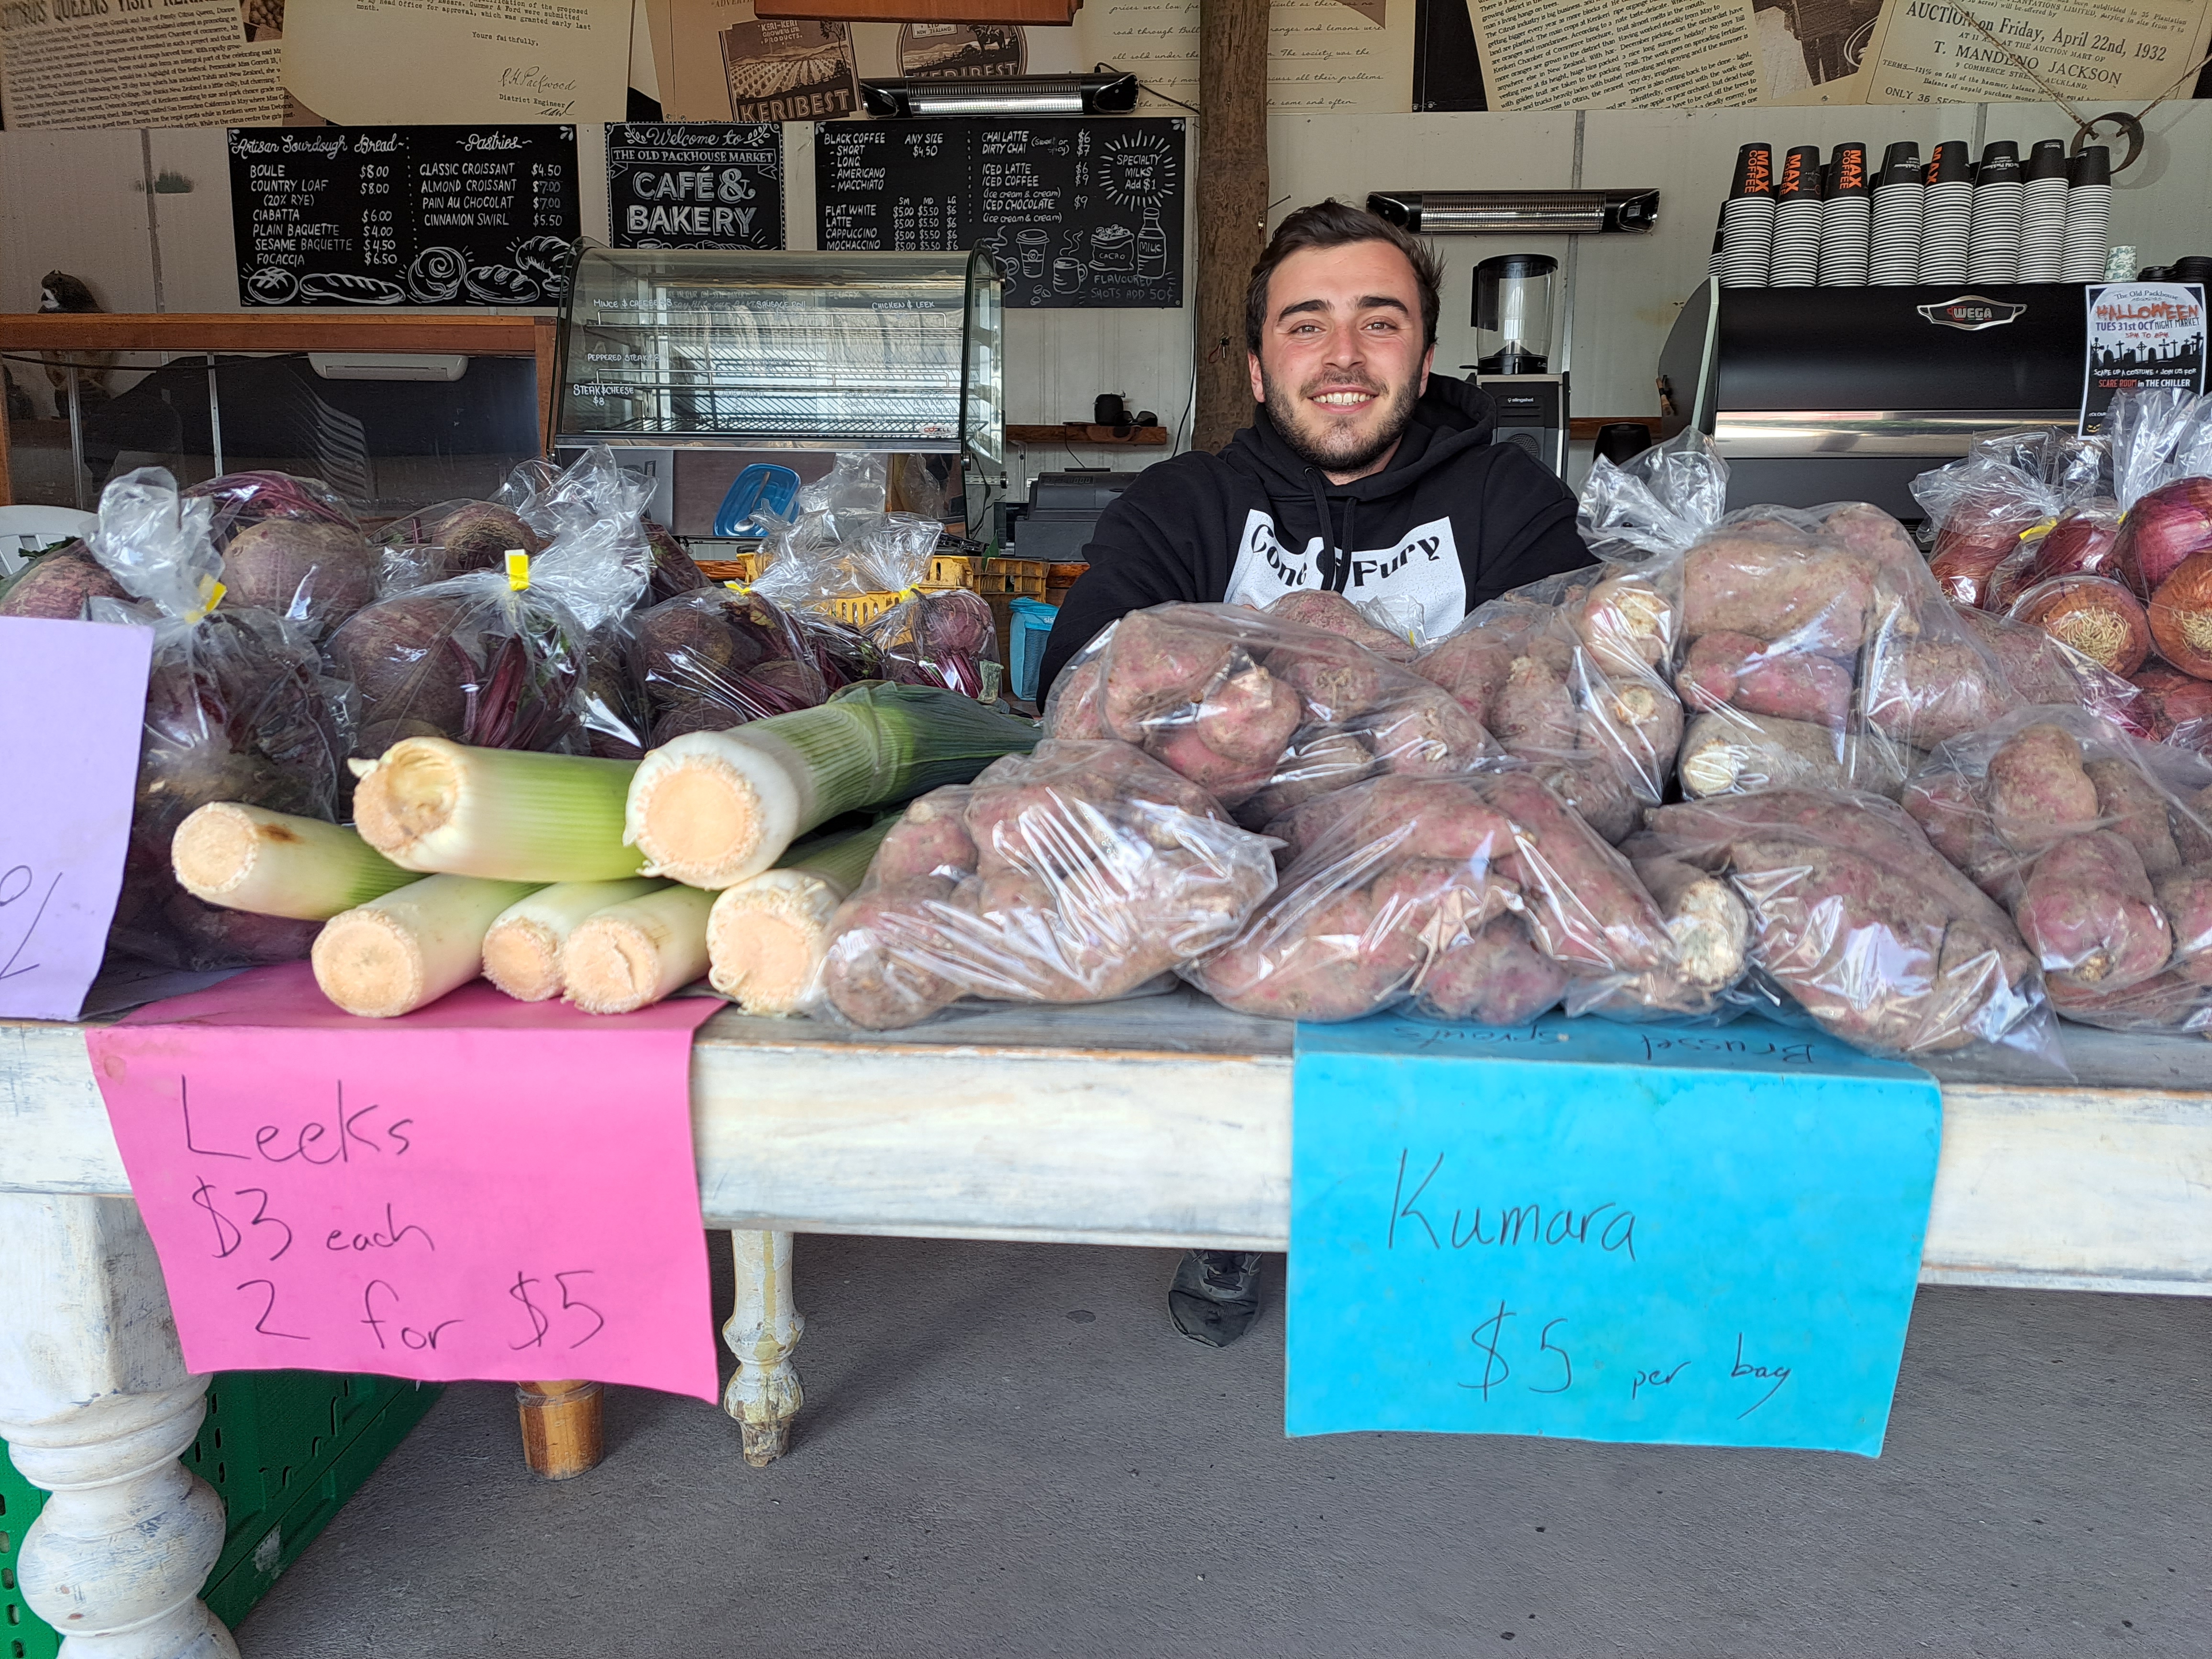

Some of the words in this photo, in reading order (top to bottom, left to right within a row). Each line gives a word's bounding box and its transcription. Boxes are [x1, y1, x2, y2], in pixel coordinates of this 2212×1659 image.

[1698, 12, 1728, 24] orchardist
[760, 20, 798, 32] KERI-KERI
[1906, 1, 1975, 28] AUCTION
[1979, 20, 1993, 31] on
[1999, 17, 2045, 42] Friday,
[2052, 27, 2089, 47] April
[2090, 34, 2126, 57] 22nd,
[2134, 43, 2167, 61] 1932
[472, 31, 493, 40] Yours
[497, 34, 539, 46] faithfully,
[1553, 41, 1584, 53] Commerce
[1585, 31, 1614, 43] brochure,
[1620, 38, 1650, 50] December
[1651, 30, 1674, 42] picking,
[1301, 49, 1333, 59] society
[1934, 41, 1946, 55] T.
[1956, 44, 2038, 69] MANDENO
[2048, 61, 2123, 85] JACKSON
[1964, 63, 2005, 75] COMMERCE
[2045, 77, 2088, 90] AUCKLAND.
[499, 94, 530, 104] District
[534, 98, 565, 108] Engineer
[740, 88, 849, 121] KERIBEST
[465, 131, 522, 151] Pastries
[647, 126, 719, 146] Welcome
[723, 129, 745, 146] to
[824, 133, 851, 144] BLACK
[853, 133, 885, 144] COFFEE
[905, 133, 923, 144] ANY
[925, 133, 943, 144] SIZE
[982, 132, 1001, 143] CHAI
[1002, 131, 1029, 142] LATTE
[1078, 129, 1091, 144] $6
[237, 138, 279, 159] Artisan
[283, 135, 348, 159] Sourdough
[354, 133, 397, 153] Bread
[836, 145, 865, 156] SHORT
[913, 145, 938, 158] $4.50
[982, 144, 1006, 155] DIRTY
[1006, 144, 1026, 154] CHAI
[1076, 144, 1090, 156] $7
[614, 150, 635, 160] THE
[638, 151, 659, 160] OLD
[663, 151, 727, 162] PACKHOUSE
[729, 151, 774, 162] MARKET
[837, 156, 861, 167] LONG
[1117, 154, 1162, 166] SPECIALTY
[250, 165, 285, 178] BOULE
[360, 165, 389, 179] $8.00
[420, 163, 458, 176] CLASSIC
[462, 163, 515, 176] CROISSANT
[531, 164, 561, 177] $4.50
[837, 167, 885, 179] AMERICANO
[982, 163, 1002, 175] ICED
[1005, 163, 1032, 175] LATTE
[1075, 162, 1088, 175] $6
[1125, 167, 1153, 178] MILKS
[1744, 150, 1758, 194] COFFEE
[1755, 150, 1769, 193] MAX
[1839, 150, 1851, 189] COFFEE
[1848, 150, 1862, 188] MAX
[250, 180, 298, 192] COUNTRY
[302, 179, 328, 191] LOAF
[360, 182, 389, 195] $8.00
[421, 180, 461, 193] ALMOND
[466, 179, 517, 192] CROISSANT
[533, 180, 561, 193] $7.00
[633, 166, 714, 201] CAFÉ
[718, 168, 756, 203] &
[837, 179, 885, 191] MACCHIATO
[982, 176, 1002, 187] ICED
[1005, 175, 1039, 187] COFFEE
[1075, 175, 1089, 187] $9
[1125, 179, 1141, 190] Add
[1143, 179, 1156, 193] $1
[291, 194, 315, 206] RYE)
[422, 196, 444, 209] PAIN
[447, 196, 460, 209] AU
[464, 196, 514, 209] CHOCOLAT
[533, 197, 561, 210] $7.00
[899, 197, 910, 205] SM
[983, 199, 1003, 210] ICED
[1005, 199, 1055, 210] CHOCOLATE
[1074, 195, 1088, 210] $9
[253, 209, 300, 222] CIABATTA
[362, 210, 392, 223] $6.00
[825, 205, 846, 217] FLAT
[849, 204, 876, 216] WHITE
[893, 206, 914, 218] $5.00
[918, 206, 939, 217] $5.50
[947, 206, 957, 215] $6
[424, 213, 474, 226] CINNAMON
[477, 213, 509, 226] SWIRL
[533, 214, 562, 227] $5.50
[627, 205, 757, 237] BAKERY
[826, 217, 852, 228] LATTE
[894, 218, 914, 230] $5.00
[918, 218, 939, 228] $5.50
[946, 217, 957, 229] $6
[253, 224, 283, 237] PLAIN
[288, 223, 340, 236] BAGUETTE
[363, 225, 393, 238] $4.00
[826, 228, 877, 239] CAPPUCCINO
[895, 230, 915, 240] $5.00
[919, 230, 940, 240] $5.50
[947, 229, 958, 239] $6
[255, 239, 296, 251] SESAME
[301, 238, 352, 251] BAGUETTE
[364, 239, 396, 251] $4.50
[827, 240, 880, 250] MOCHACCINO
[895, 242, 916, 251] $5.00
[920, 241, 940, 251] $5.50
[1139, 242, 1162, 254] MILK
[257, 253, 304, 265] FOCACCIA
[364, 252, 397, 266] $6.50
[1099, 252, 1126, 260] CACAO
[1094, 275, 1152, 286] FLAVOURED
[1091, 288, 1121, 299] SHOTS
[1126, 289, 1145, 299] ADD
[2145, 290, 2179, 301] Packhouse
[594, 299, 619, 308] MINCE
[872, 302, 906, 310] CHICKEN
[1953, 308, 1992, 318] WEGA
[2095, 301, 2200, 321] HALLOWEEN
[2095, 322, 2116, 331] TUES
[2118, 321, 2136, 331] 31st
[2138, 320, 2154, 331] OCT
[2175, 318, 2200, 327] MARKET
[587, 354, 622, 362] PEPPERED
[2099, 379, 2118, 387] SCARE
[593, 397, 605, 406] $8
[1352, 536, 1441, 587] Fury
[1394, 1025, 1561, 1050] sprouts
[1641, 1033, 1815, 1064] Brussel
[181, 1073, 414, 1165] Leeks
[1387, 1148, 1637, 1262] Kumara
[192, 1175, 293, 1261] $3
[326, 1203, 434, 1253] each
[236, 1278, 311, 1340] 2
[361, 1278, 464, 1350] for
[509, 1270, 605, 1350] $5
[1457, 1301, 1574, 1403] $5
[1631, 1359, 1692, 1402] per
[1729, 1332, 1793, 1421] bag
